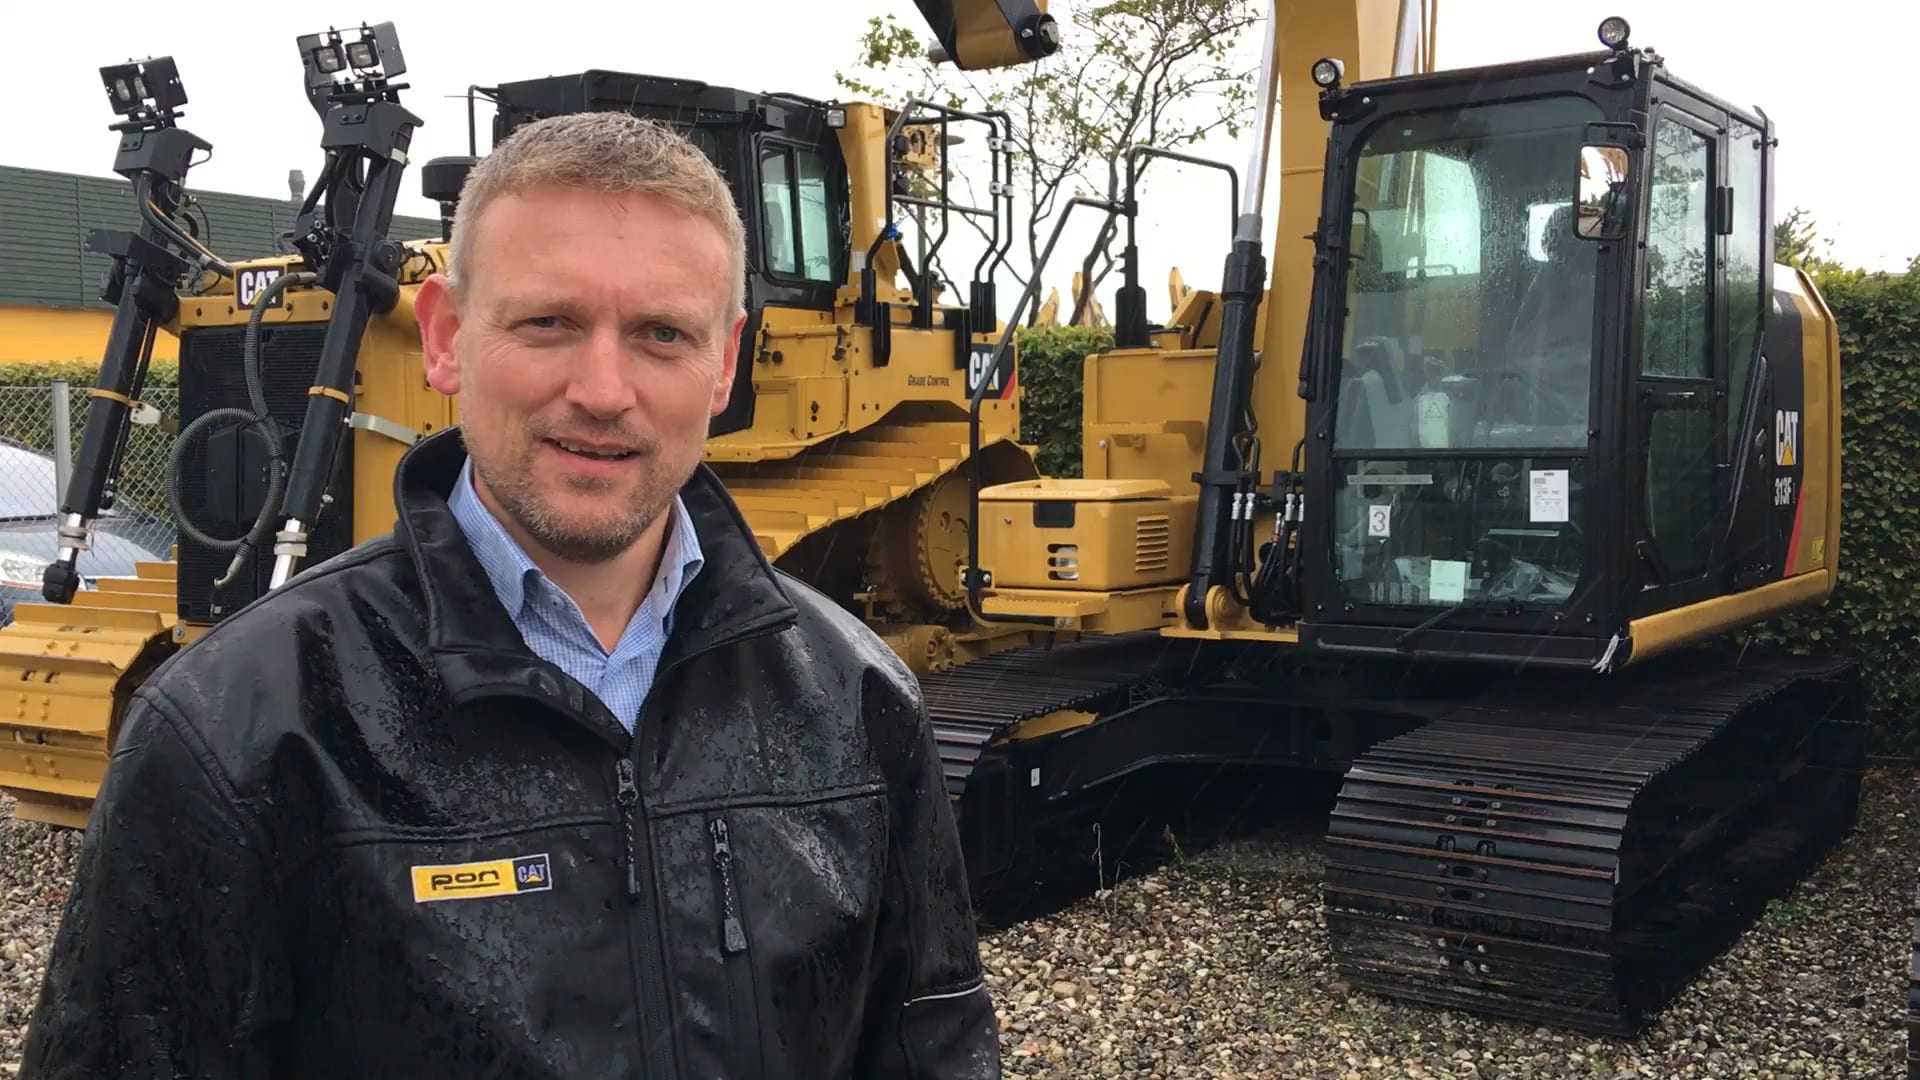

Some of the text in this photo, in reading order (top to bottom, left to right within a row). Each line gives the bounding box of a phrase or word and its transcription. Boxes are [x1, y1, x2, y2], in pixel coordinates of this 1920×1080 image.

[1775, 409, 1798, 466] CAT
[1774, 477, 1792, 506] 313F
[1372, 511, 1386, 533] 3
[518, 864, 545, 883] CAT
